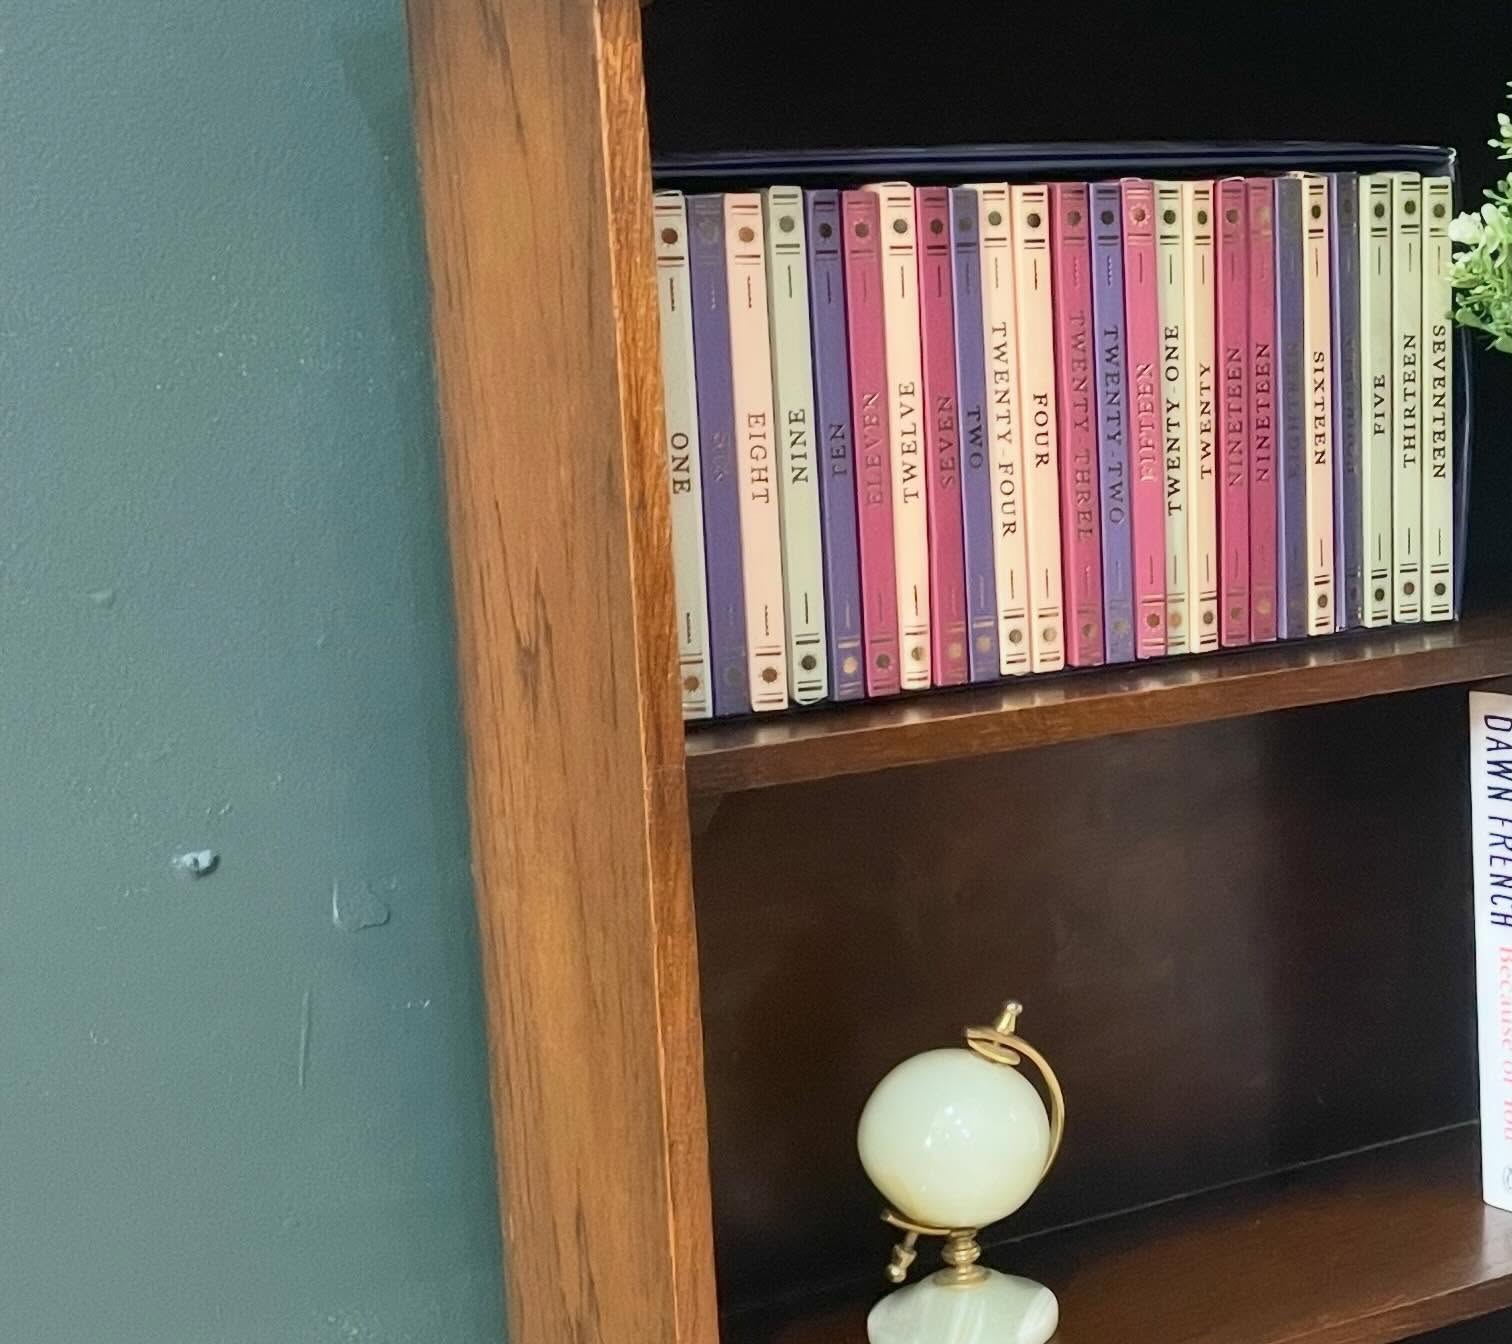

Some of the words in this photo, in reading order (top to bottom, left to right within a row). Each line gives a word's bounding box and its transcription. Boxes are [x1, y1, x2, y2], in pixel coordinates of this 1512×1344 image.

[788, 409, 808, 484] NINE
[830, 423, 847, 478] TEN
[863, 392, 884, 506] ELEVEN
[898, 382, 919, 504] TWELVE
[937, 394, 954, 488] SEVEN
[967, 408, 983, 470] TWO
[1033, 392, 1049, 469] FOUR
[1136, 363, 1157, 482] FIFTEEN
[1199, 363, 1212, 479] TWENTY
[1229, 347, 1243, 486] NINETEEN
[1256, 342, 1270, 482] NINETEEN
[1314, 351, 1326, 466] SIXTEEN
[1374, 374, 1385, 435] FIVE
[1403, 333, 1416, 469] THIRTEEN
[1433, 325, 1446, 480] SEVENTEEN
[671, 433, 691, 494] ONE
[747, 413, 769, 504] EIGHT
